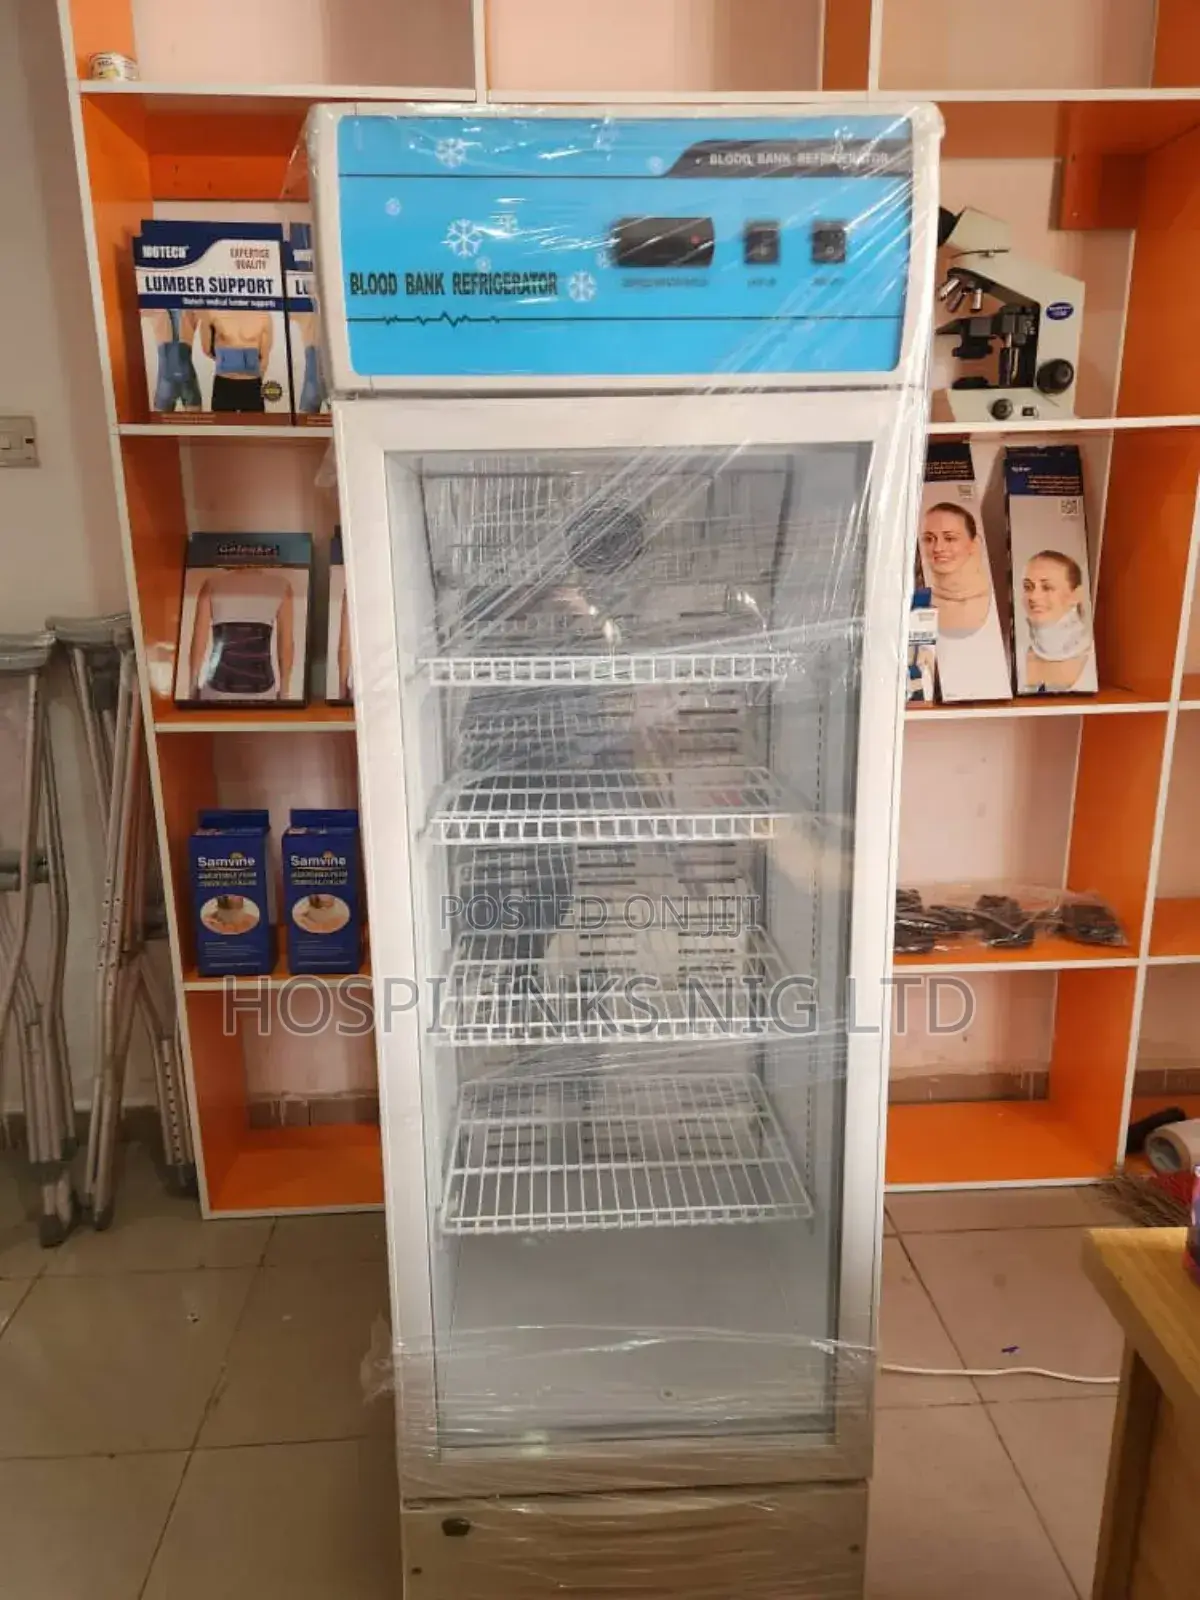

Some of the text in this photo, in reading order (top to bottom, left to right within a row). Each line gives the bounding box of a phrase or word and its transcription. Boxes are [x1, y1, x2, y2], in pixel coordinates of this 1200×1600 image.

[709, 152, 751, 166] BLOOD
[757, 152, 791, 165] BANK
[144, 275, 274, 295] LUMBER SUPPORT
[350, 271, 559, 296] BLOOD BANK REFRIGERATOR
